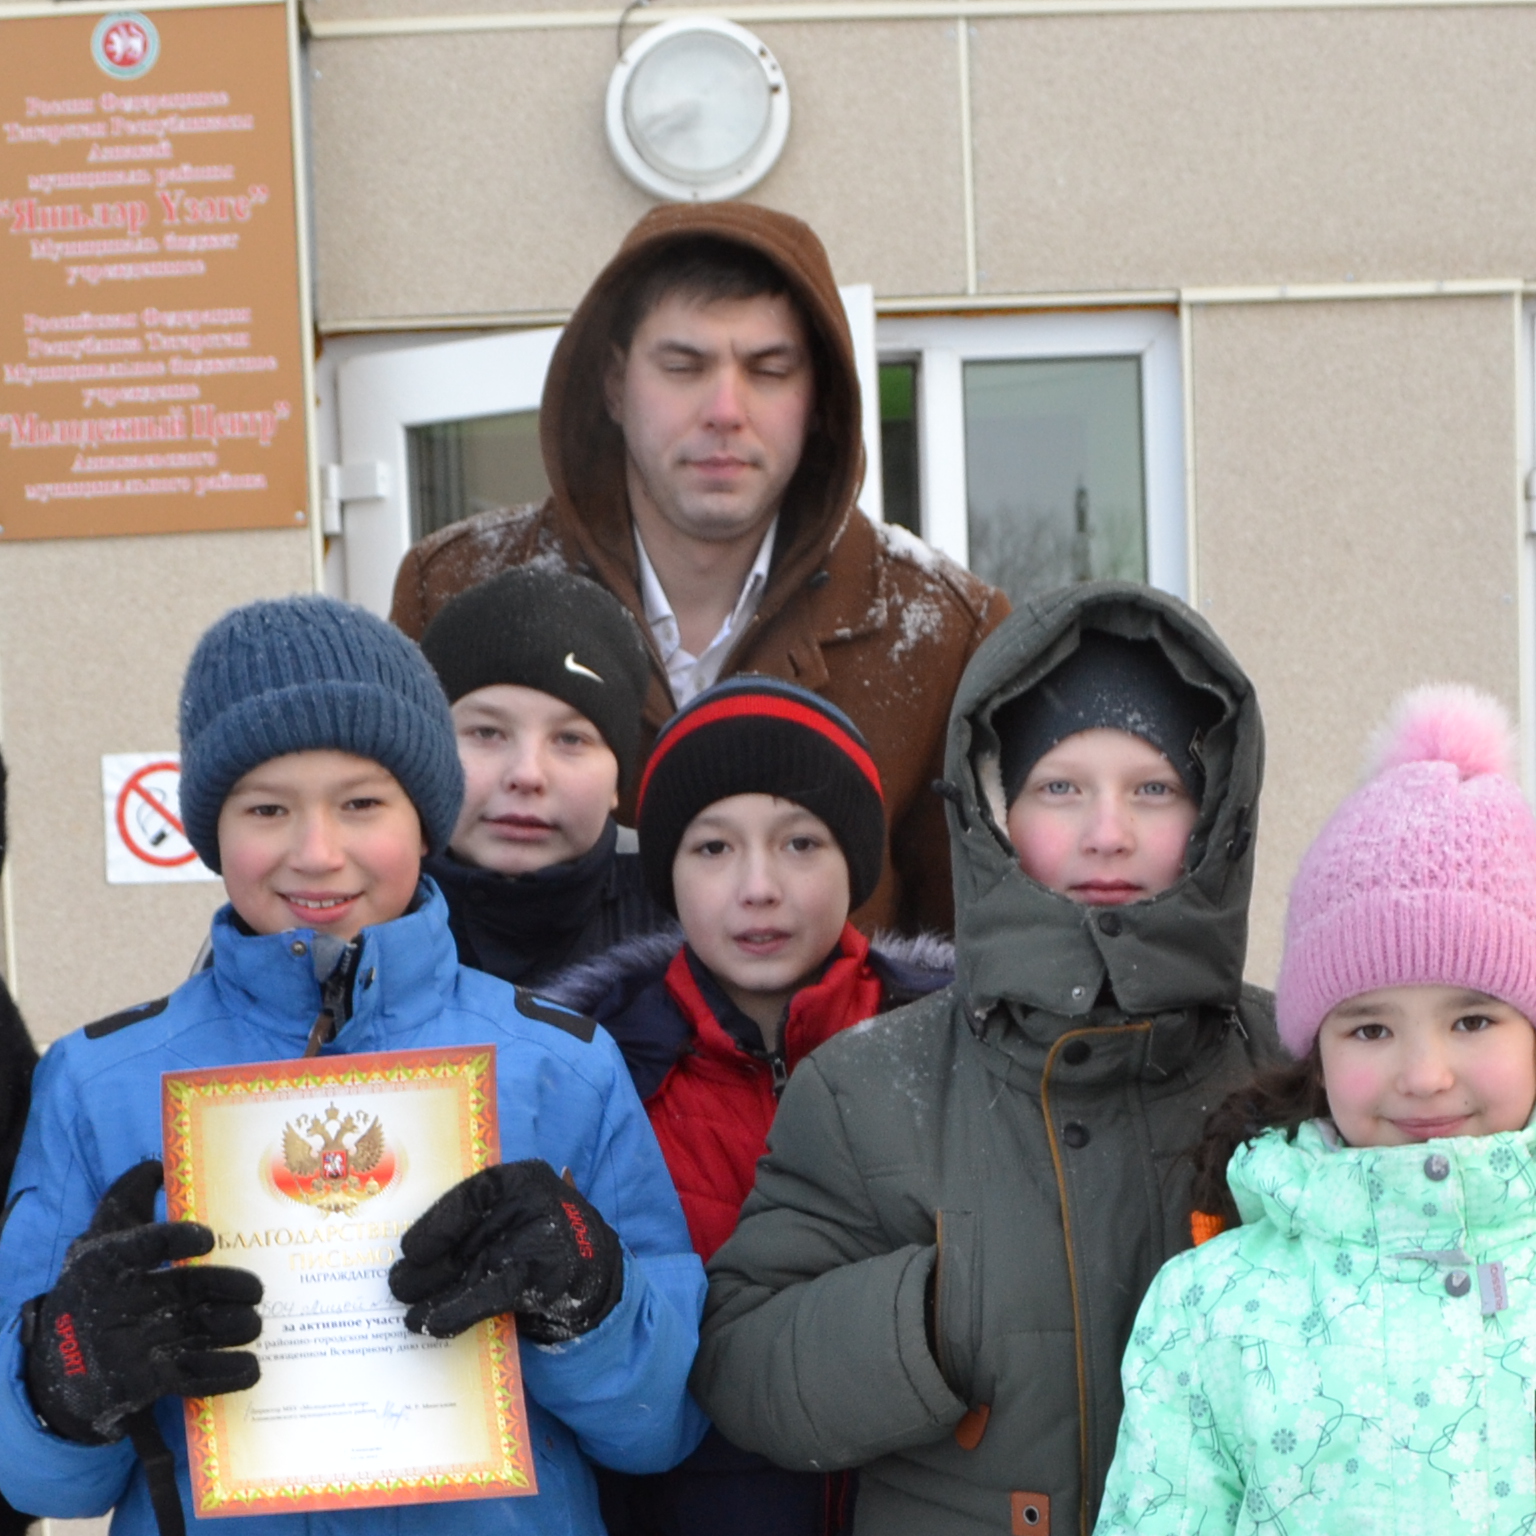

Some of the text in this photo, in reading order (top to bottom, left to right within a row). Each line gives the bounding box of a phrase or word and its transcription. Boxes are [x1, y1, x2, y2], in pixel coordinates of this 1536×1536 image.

[288, 1246, 395, 1272] ПИСЬМО
[299, 1268, 390, 1285] НАГРАЖДАЕТС
[282, 1314, 405, 1333] за активное участ
[54, 1312, 89, 1378] SPORT
[330, 1343, 394, 1359] Всемирному
[396, 1343, 419, 1353] дню
